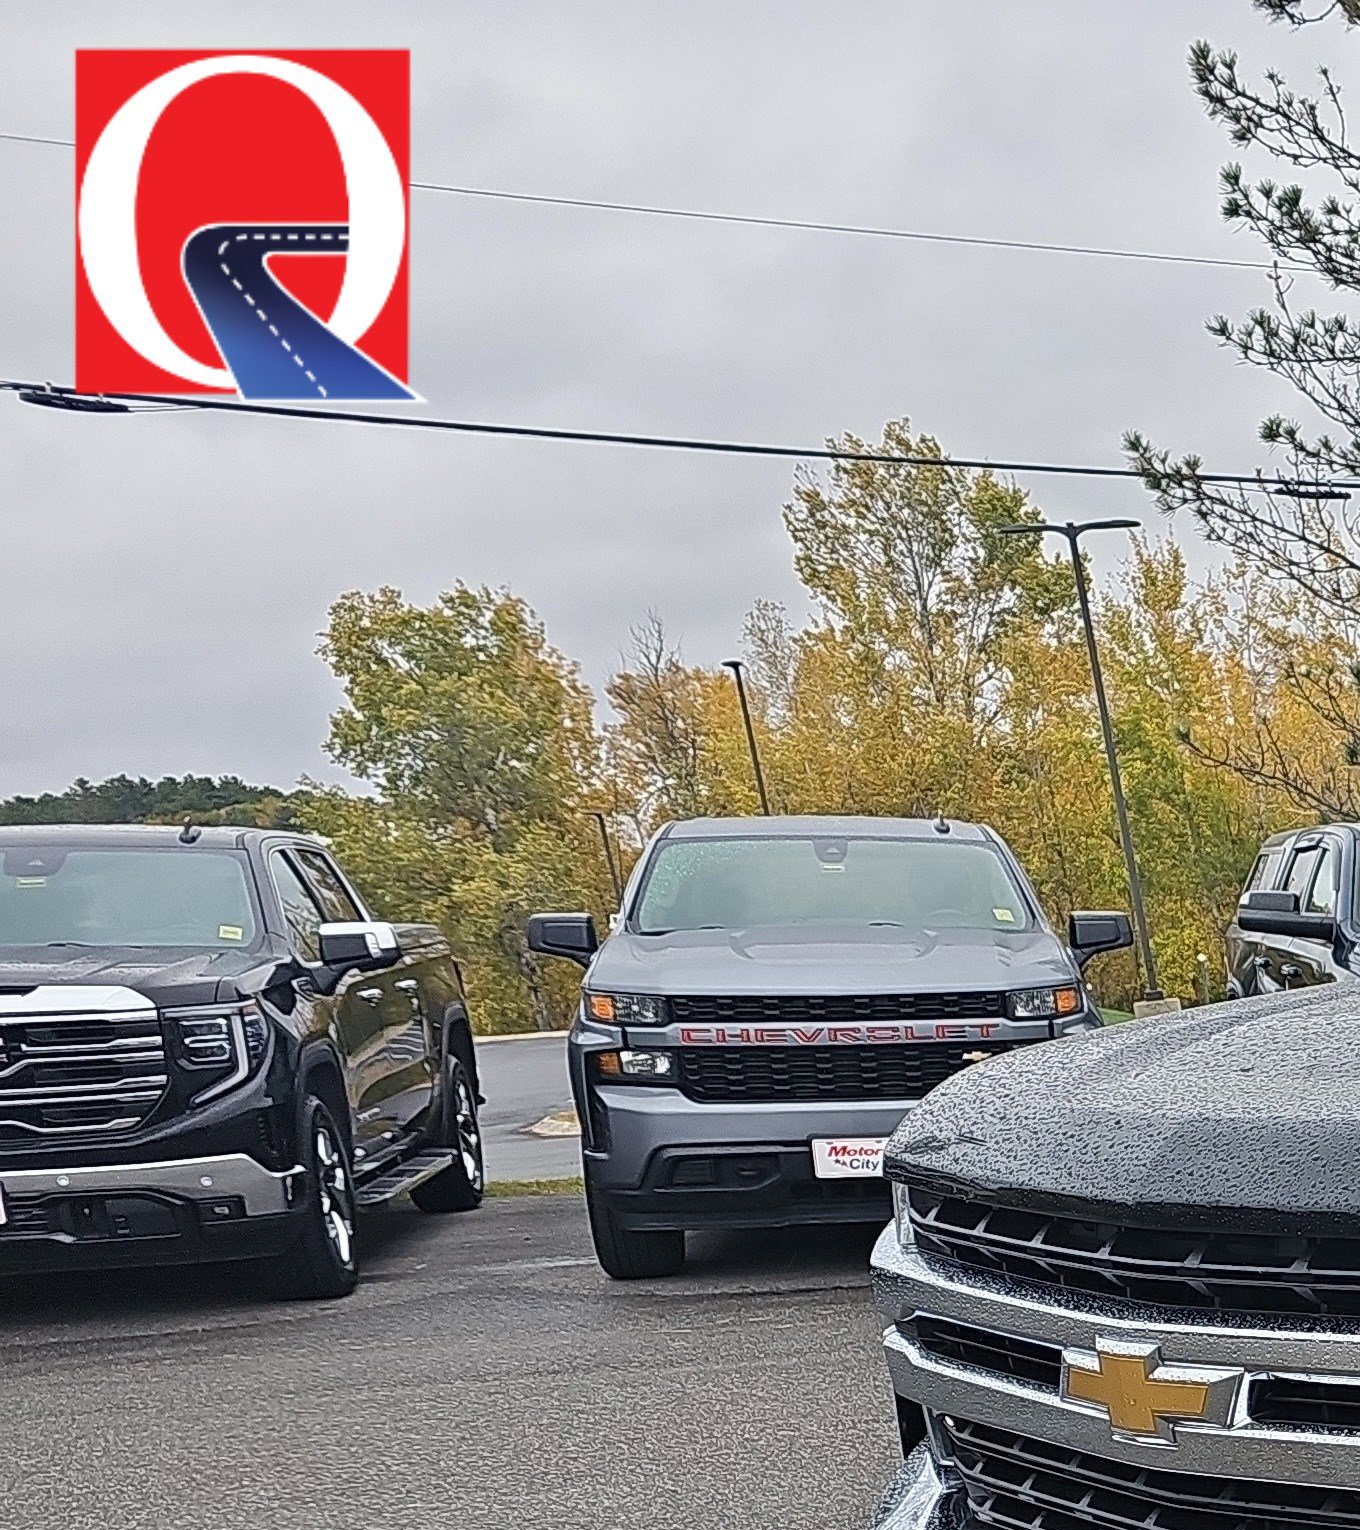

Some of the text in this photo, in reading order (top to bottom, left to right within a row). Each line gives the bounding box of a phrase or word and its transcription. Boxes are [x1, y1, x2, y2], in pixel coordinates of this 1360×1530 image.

[680, 1023, 1001, 1046] CHEVROLET
[827, 1145, 883, 1158] Motor
[849, 1158, 880, 1171] City
